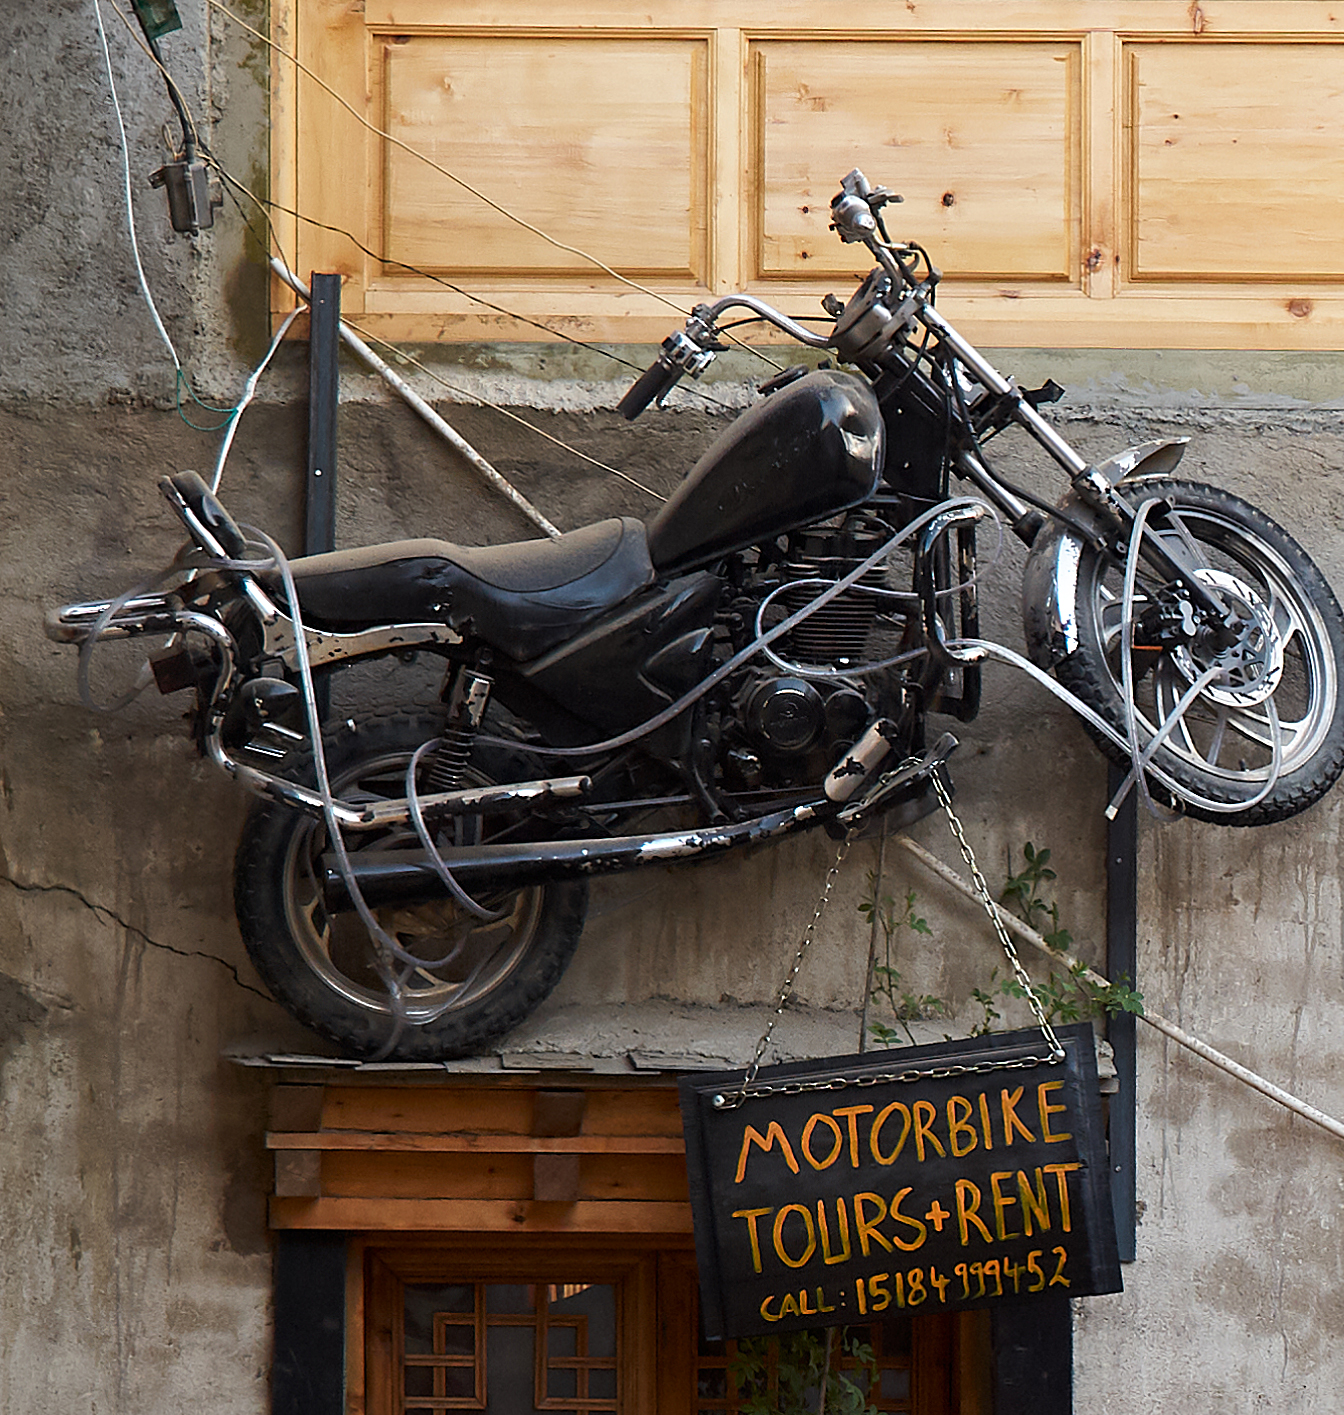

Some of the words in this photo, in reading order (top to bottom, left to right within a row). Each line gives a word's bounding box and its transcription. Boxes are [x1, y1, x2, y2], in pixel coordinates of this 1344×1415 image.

[734, 1080, 1073, 1183] MOTORBIKE
[732, 1162, 1084, 1273] TOURS+RENT
[760, 1287, 847, 1322] CALL:
